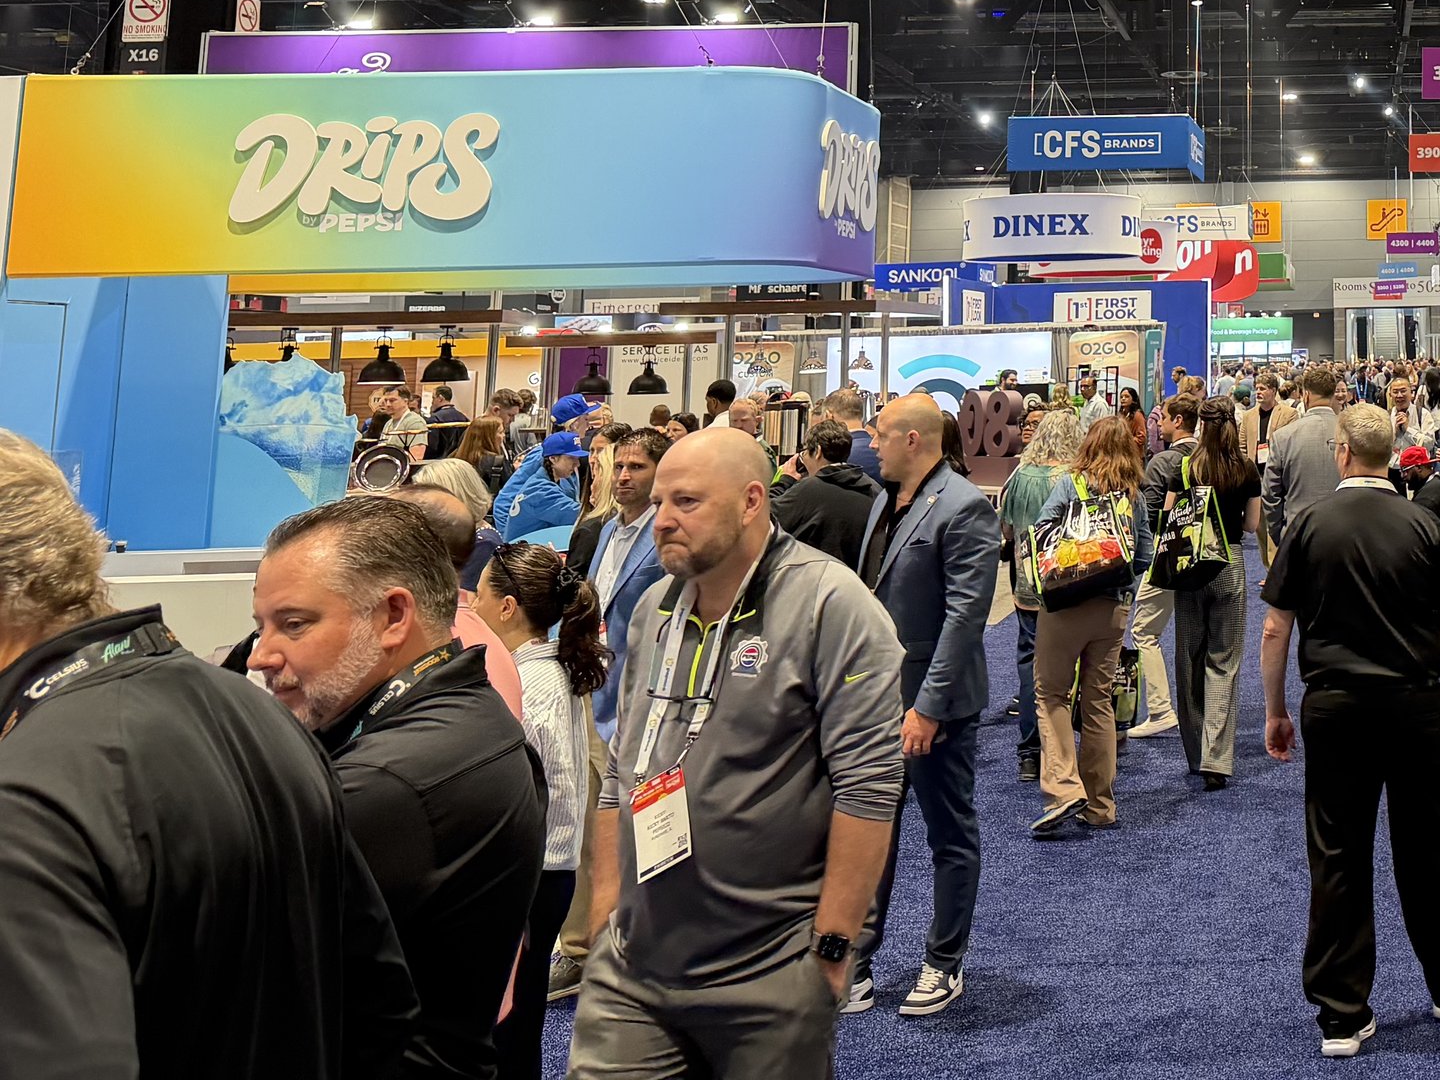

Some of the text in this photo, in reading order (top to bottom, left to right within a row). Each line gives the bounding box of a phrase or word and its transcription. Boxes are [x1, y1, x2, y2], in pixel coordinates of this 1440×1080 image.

[123, 25, 134, 33] NO
[128, 48, 159, 62] X16
[1043, 130, 1155, 159] CFS BRANDS
[319, 212, 403, 234] PEPSI
[993, 213, 1090, 238] DINEX
[1200, 218, 1233, 228] BRANDS
[1390, 239, 1435, 247] 4300 4400
[1334, 282, 1367, 292] Rooms
[1095, 308, 1137, 320] LOOK
[46, 658, 88, 685] CELSIUS
